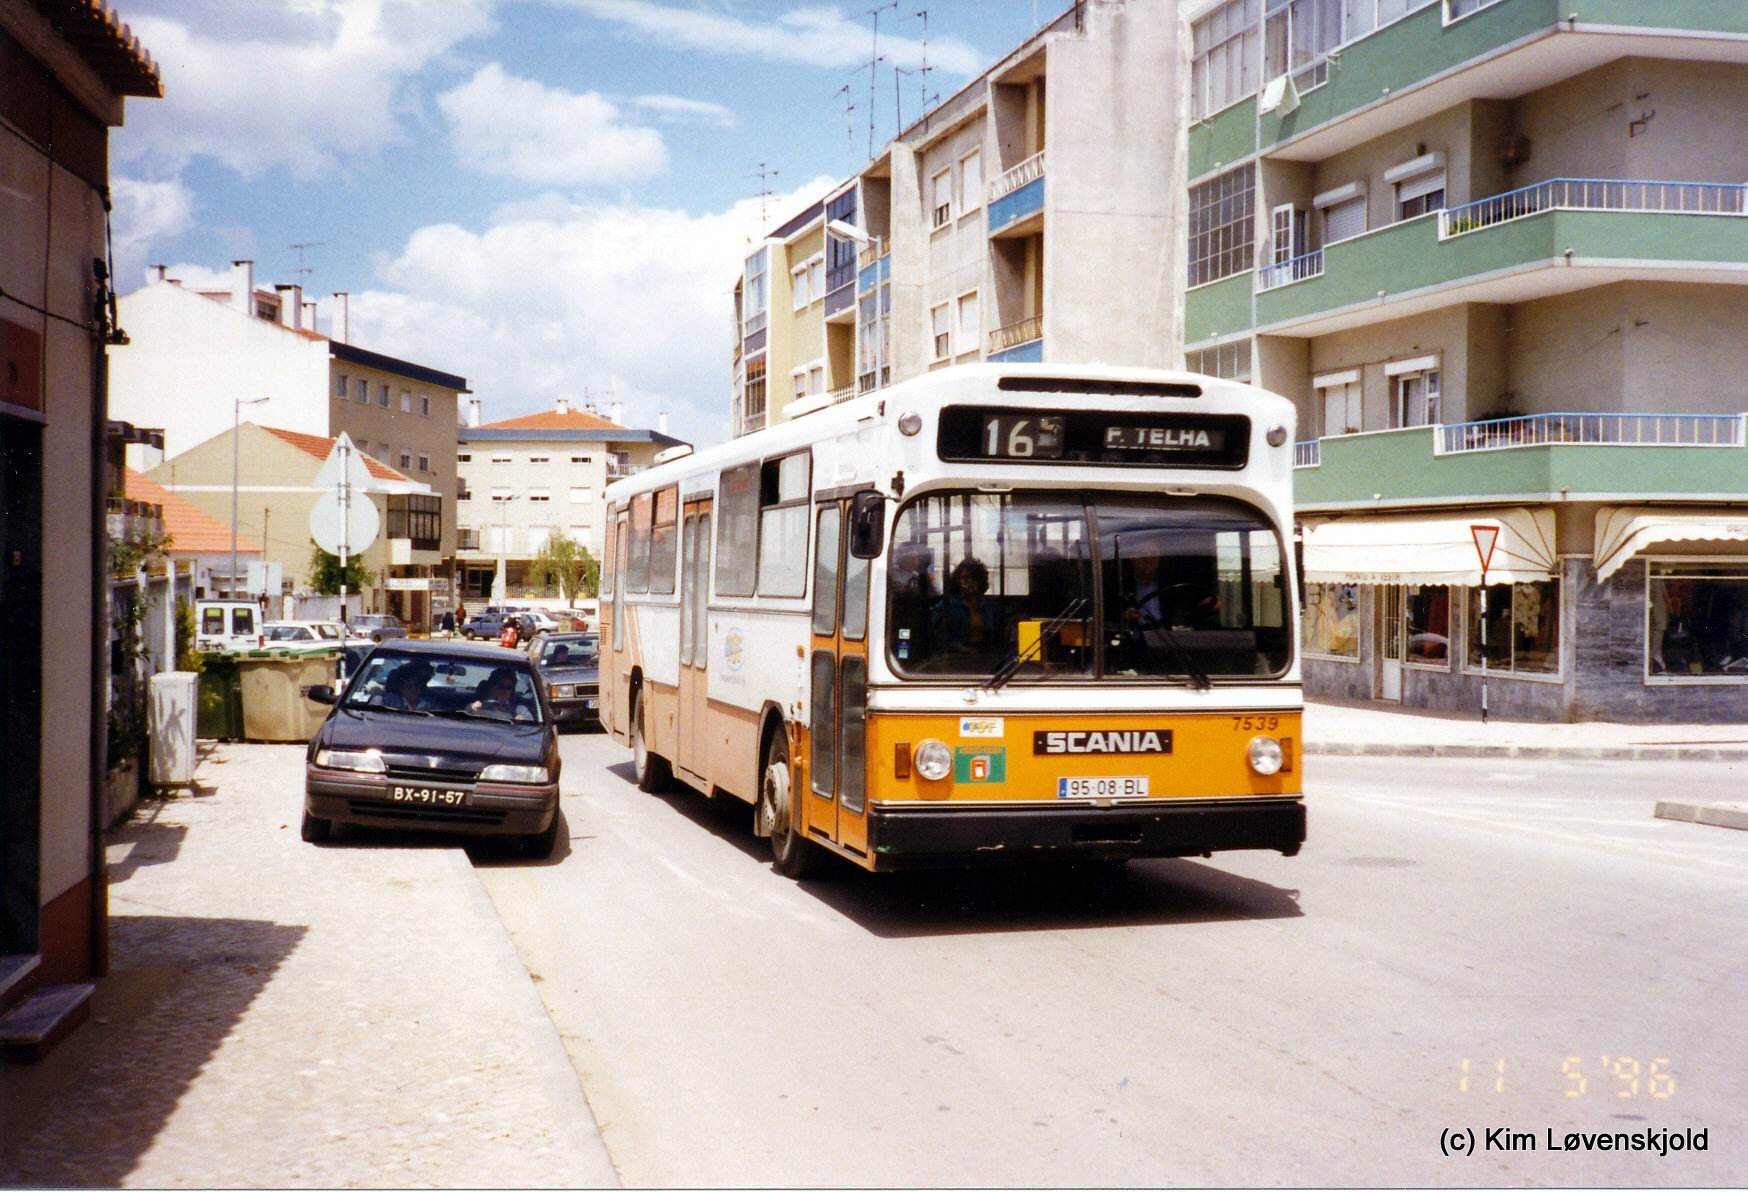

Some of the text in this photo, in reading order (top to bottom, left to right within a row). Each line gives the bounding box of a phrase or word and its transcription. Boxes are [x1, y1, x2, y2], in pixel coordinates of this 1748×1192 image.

[987, 419, 1033, 457] 16
[1107, 427, 1210, 446] F. TELHA
[1233, 716, 1279, 731] 7539
[1046, 731, 1162, 753] SCANIA
[394, 787, 464, 805] BX-91-57
